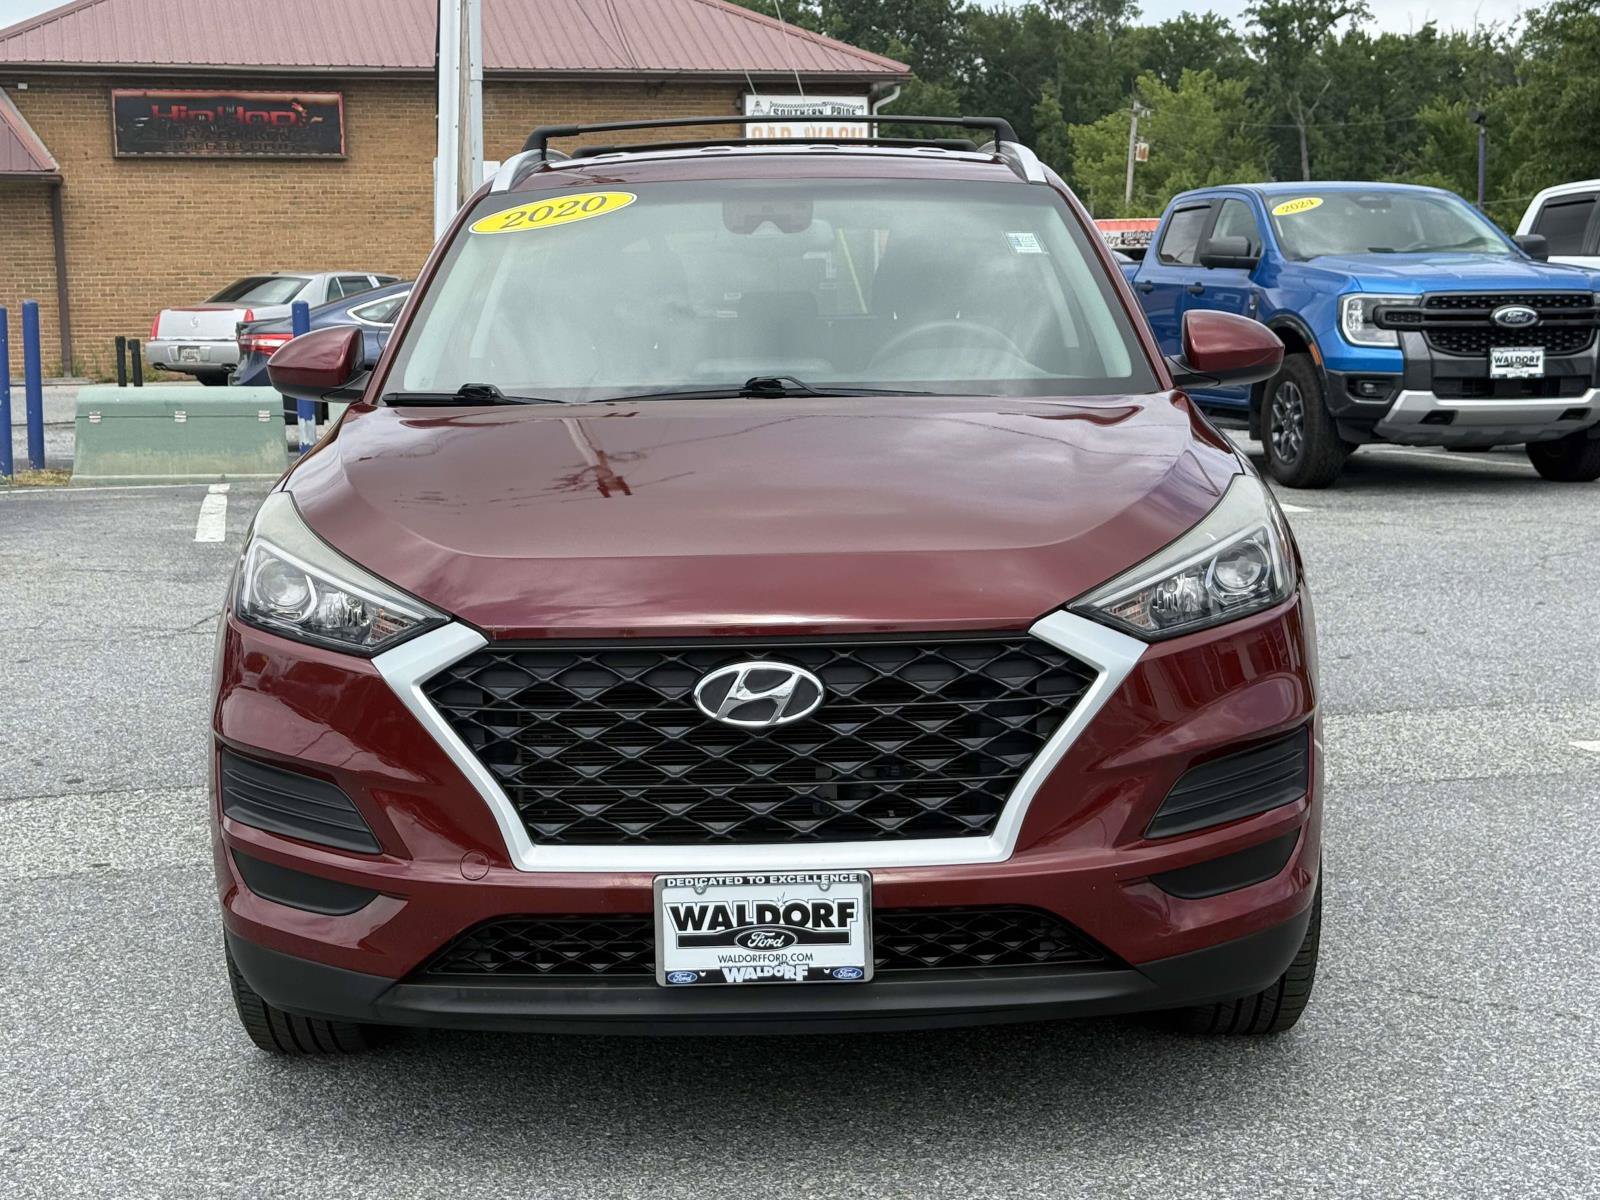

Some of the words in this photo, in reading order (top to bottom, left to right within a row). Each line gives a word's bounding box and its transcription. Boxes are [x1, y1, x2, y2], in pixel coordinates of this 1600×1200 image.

[499, 195, 607, 230] 2020
[1505, 310, 1528, 322] Ford
[1494, 355, 1540, 364] WALDORF
[667, 876, 745, 887] DEDICATED
[748, 875, 765, 885] TO
[769, 874, 858, 884] EXCELLENCE
[668, 901, 856, 932] WALDORF
[747, 931, 785, 948] Ford
[717, 952, 814, 964] WALDORFFORD.COM
[671, 971, 694, 983] Ford
[721, 964, 809, 983] WALDORF
[836, 968, 860, 979] Ford
